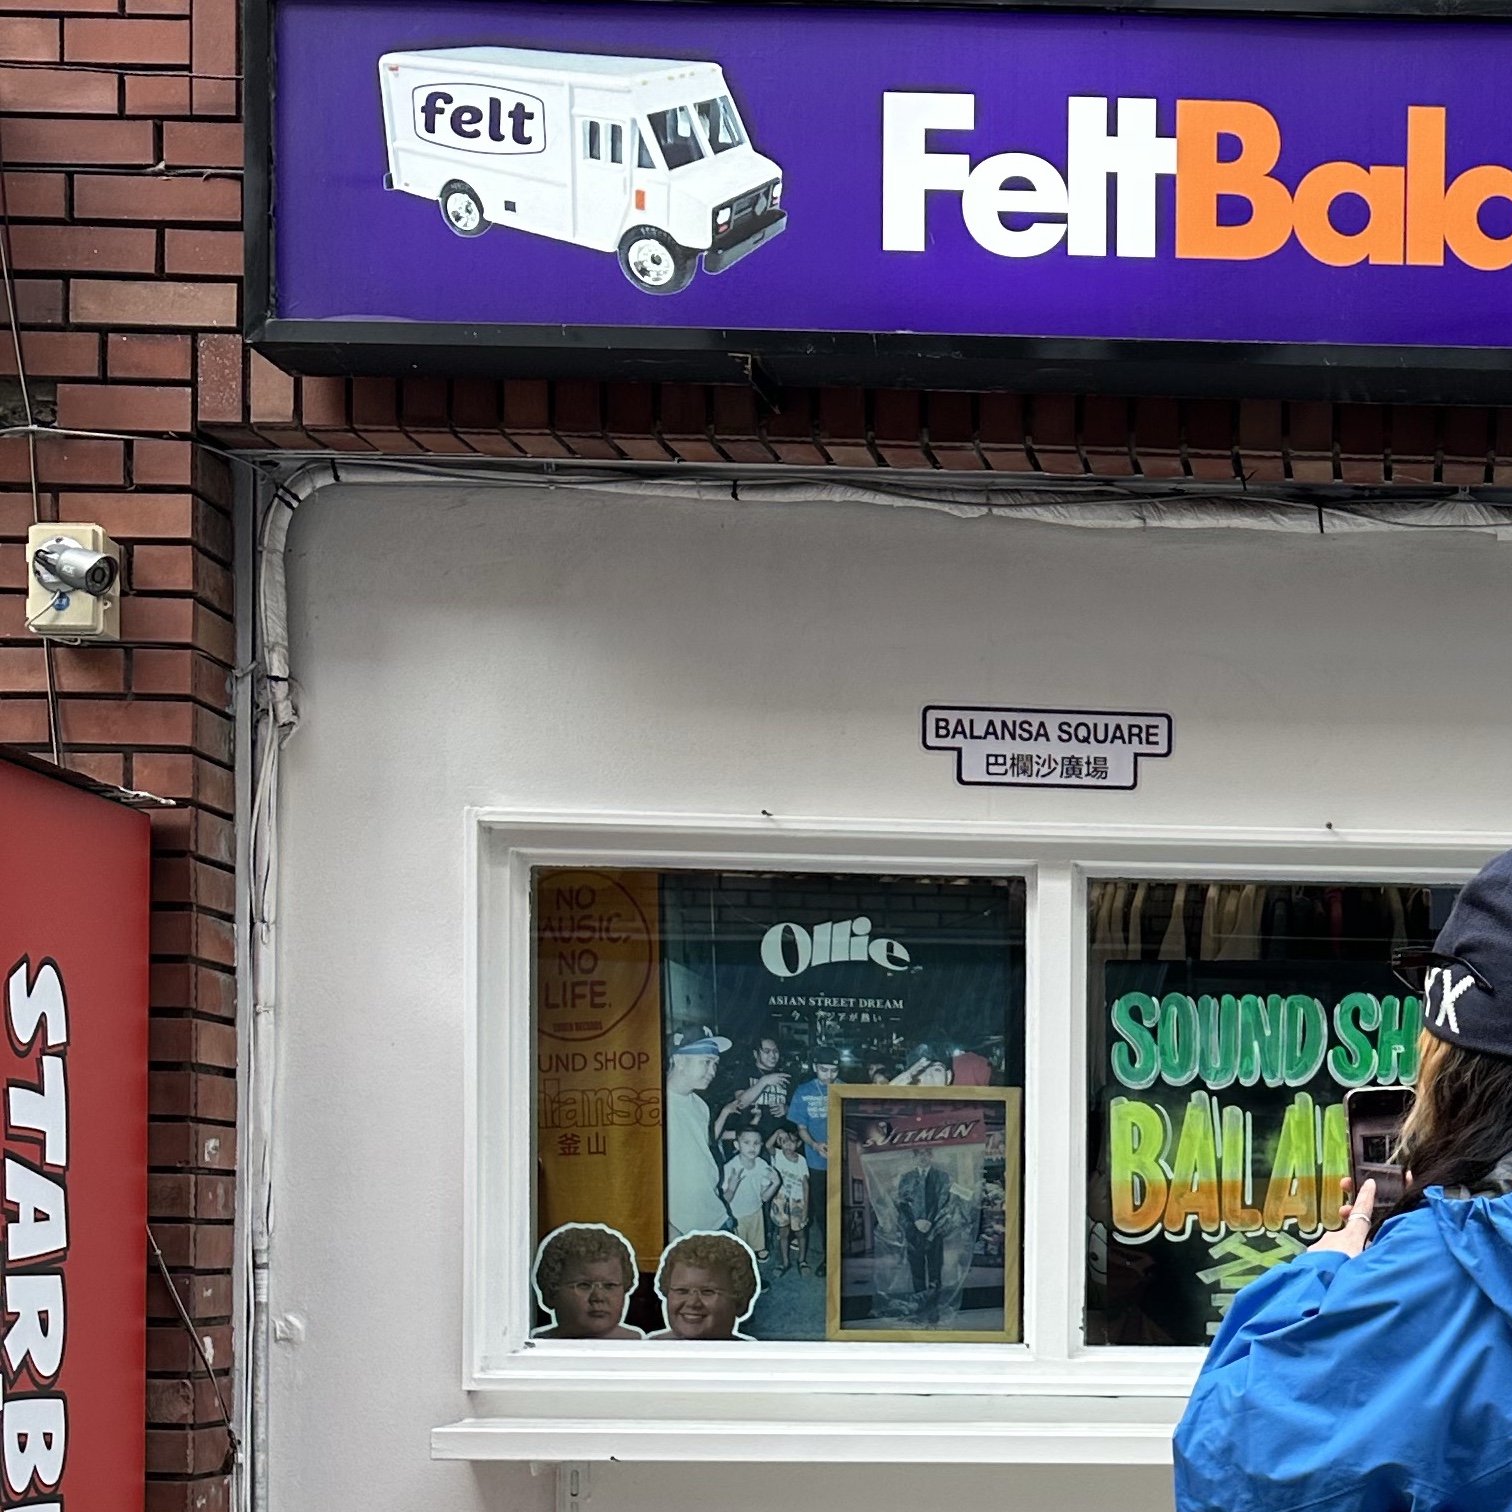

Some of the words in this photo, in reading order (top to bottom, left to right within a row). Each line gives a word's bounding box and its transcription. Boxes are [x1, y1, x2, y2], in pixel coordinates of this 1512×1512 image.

[420, 91, 535, 147] felt
[934, 717, 1050, 742] BALANSA
[1057, 722, 1160, 746] SQUARE
[985, 753, 1109, 780] 巴欄沙廣場
[556, 885, 596, 911] NO
[760, 916, 911, 978] Ollie
[558, 949, 599, 976] NO
[545, 980, 612, 1009] LIFE.
[768, 996, 806, 1006] ASIAN
[808, 997, 857, 1008] STREET
[859, 998, 904, 1009] DREAM
[1112, 991, 1327, 1090] SOUND
[594, 1050, 650, 1072] SHOP
[538, 1078, 662, 1129] lansa
[558, 1132, 606, 1156] 釜山
[863, 1120, 980, 1148] SUITMAN
